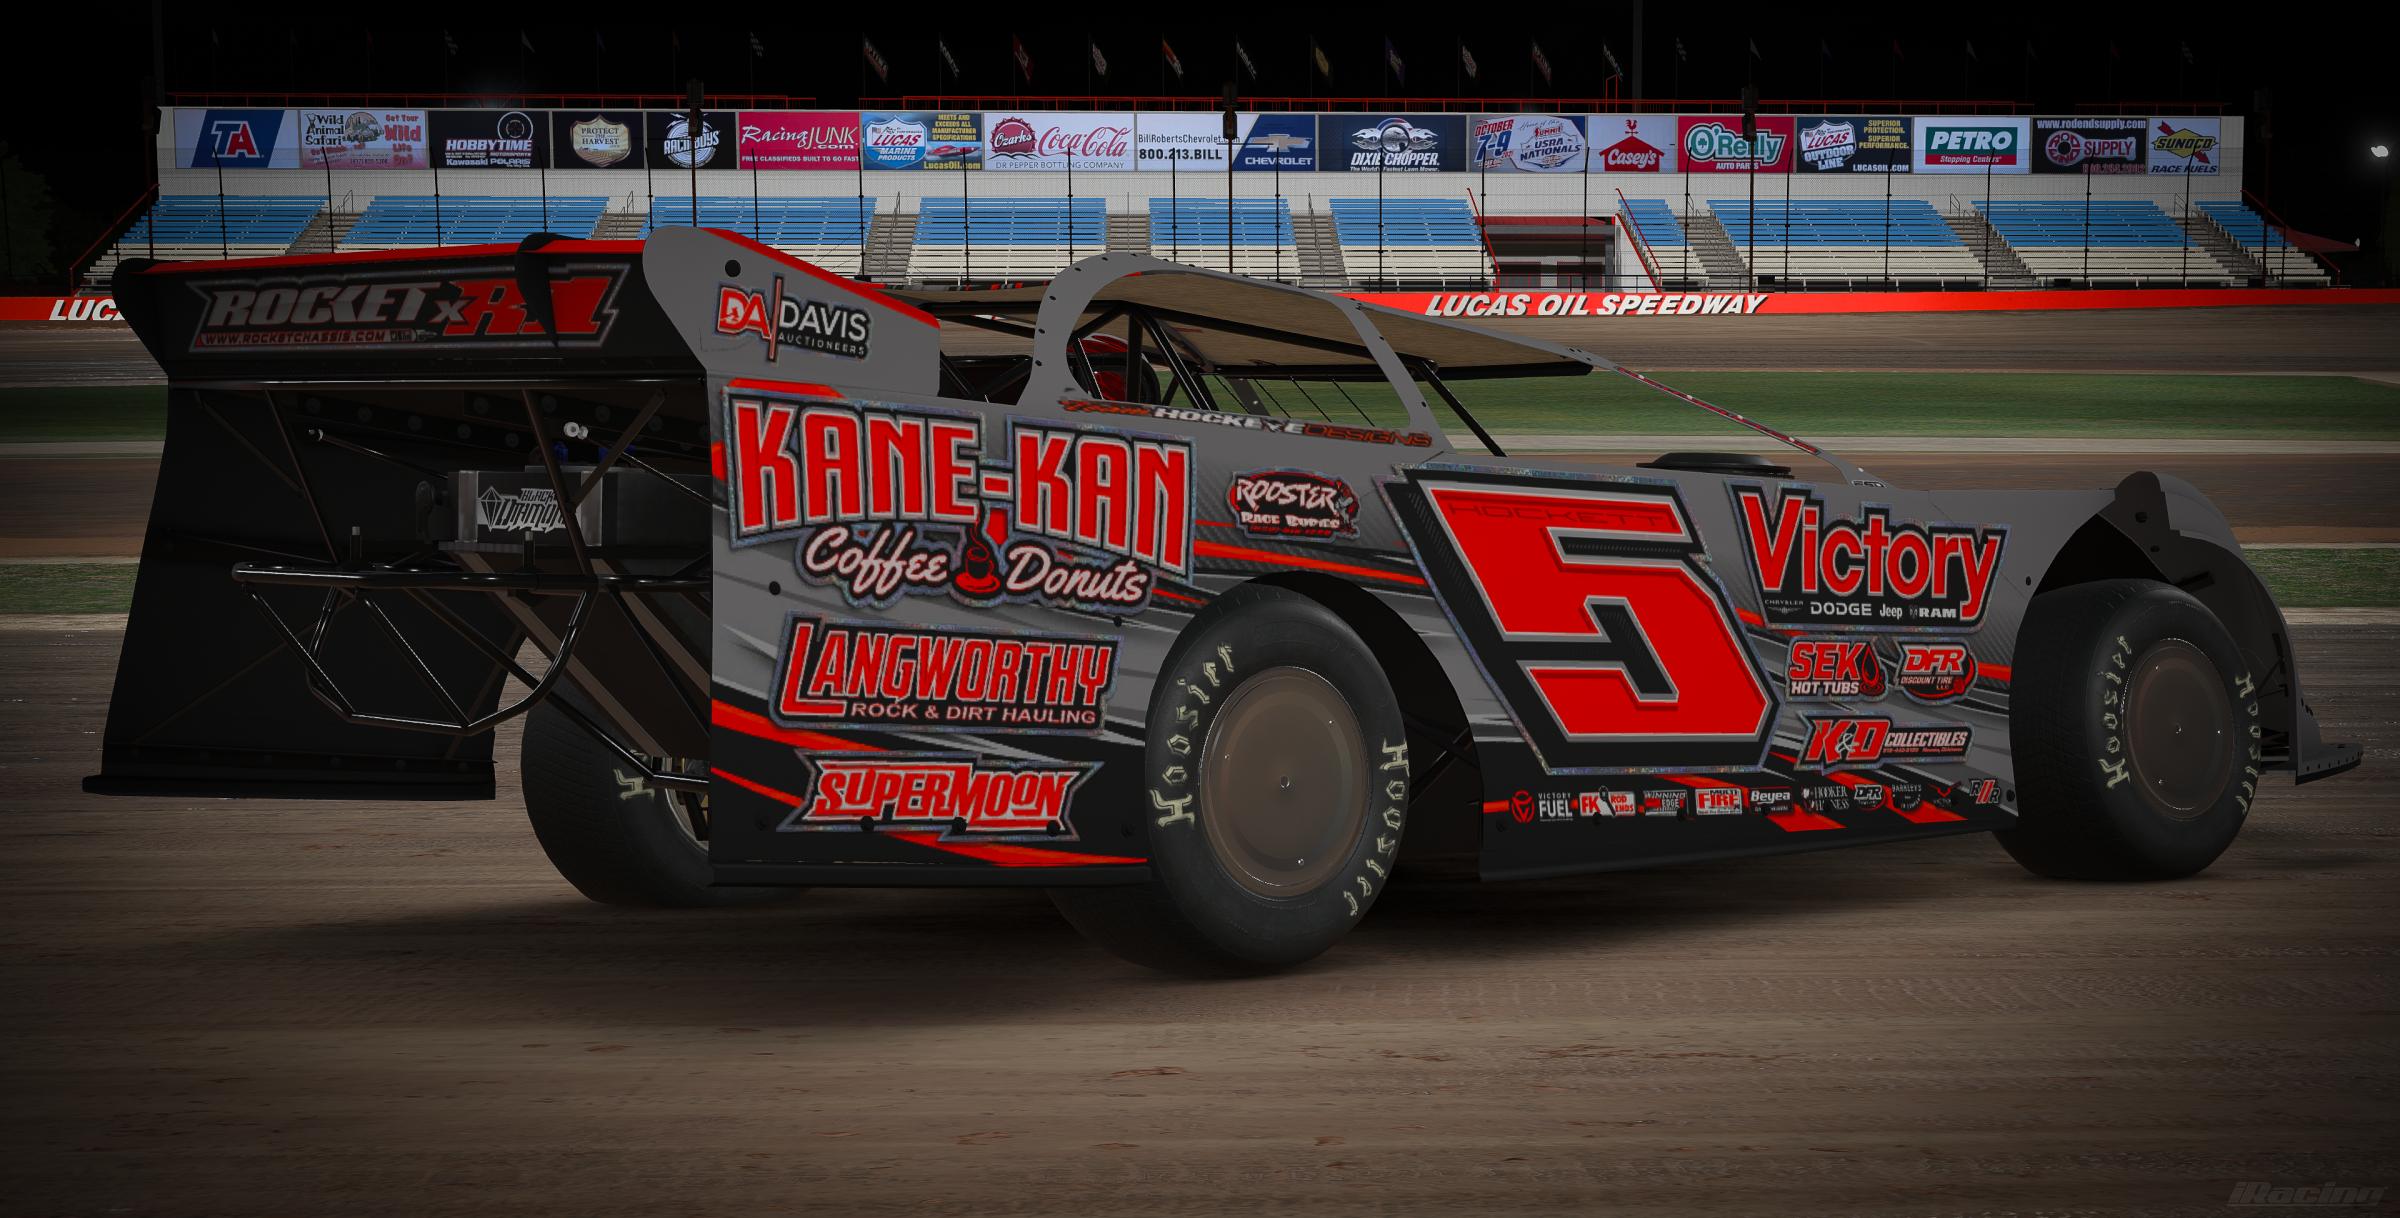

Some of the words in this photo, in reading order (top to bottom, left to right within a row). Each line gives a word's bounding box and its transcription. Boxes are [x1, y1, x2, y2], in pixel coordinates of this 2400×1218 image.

[315, 114, 344, 125] Wild
[386, 114, 398, 122] Get
[401, 114, 419, 122] Your
[1868, 119, 1901, 127] SUPERIOR
[2036, 118, 2147, 130] www.rodendsupply.com
[306, 125, 344, 135] Animal
[384, 125, 421, 142] Wild
[581, 127, 619, 135] PROTECT
[1475, 119, 1514, 137] OCTOBER
[305, 135, 342, 146] Safari
[446, 139, 533, 151] HOBBYTIME
[872, 134, 922, 146] LUCAS
[993, 130, 1032, 148] Ozarks
[1474, 130, 1512, 162] 7-9
[1535, 138, 1563, 148] USRA
[1690, 128, 1780, 160] O'Relly
[1808, 131, 1850, 149] LUCAS
[1930, 130, 2013, 150] PETRO
[2156, 138, 2214, 149] SUNOCO
[880, 147, 917, 155] MARINE
[1139, 148, 1222, 160] 800.213.BILL
[1520, 144, 1582, 161] NATIONALS
[1804, 144, 1855, 162] OUTDOOR
[2084, 141, 2133, 156] SUPPLY
[446, 158, 488, 166] Kawasaki
[996, 161, 1007, 169] DR
[1009, 161, 1039, 169] PEPPER
[1041, 161, 1081, 169] BOTTLNG
[1083, 161, 1125, 169] COMPANY
[1245, 157, 1313, 166] CHEVROLET
[1607, 148, 1657, 169] Casey's
[1716, 162, 1734, 170] AUTO
[1736, 162, 1759, 170] PARS
[1817, 157, 1845, 170] LINE
[1940, 155, 1970, 164] Stopping
[1852, 163, 1910, 172] LUCASOIL.COM
[2151, 165, 2182, 173] RACE
[206, 281, 442, 327] ROCKET
[1425, 294, 1531, 317] LUCAS
[1537, 294, 1591, 316] OIL
[1596, 294, 1768, 316] SPEEDWAY
[779, 299, 867, 342] DAVIS
[206, 329, 385, 345] WWW.ROCKETCHASSIS.COM
[778, 331, 865, 356] AUCTIONEERS
[731, 399, 1192, 577] KANE-KAN
[1236, 477, 1340, 517] ROOSTER
[804, 525, 948, 596] Coffee
[1005, 545, 1148, 602] Donuts
[1738, 490, 2002, 622] Victory
[1417, 479, 1773, 743] 5
[1810, 601, 1873, 617] DODGE
[1879, 603, 1903, 620] Jeep
[1918, 606, 1957, 619] RAM
[1788, 641, 1866, 682] SEK
[1902, 644, 1967, 676] DFR
[780, 621, 1113, 717] LANGWORTHY
[1901, 675, 1936, 685] DISCOUNT
[1937, 675, 1953, 685] TIRE
[1791, 681, 1821, 696] HOT
[1822, 681, 1860, 696] TUBS
[850, 702, 917, 719] ROCK
[924, 704, 942, 720] &
[949, 705, 998, 722] DIRT
[1002, 706, 1097, 725] HAULING
[1884, 731, 1969, 747] COLLECTIBLES
[1538, 792, 1571, 800] VICTORY
[1610, 795, 1627, 803] ROD
[1750, 789, 1791, 805] Beyea
[1854, 784, 1883, 800] DFR
[1539, 800, 1573, 818] FUEL
[1581, 796, 1601, 814] FK
[1615, 804, 1634, 812] ENDS
[1661, 799, 1680, 808] EDGE
